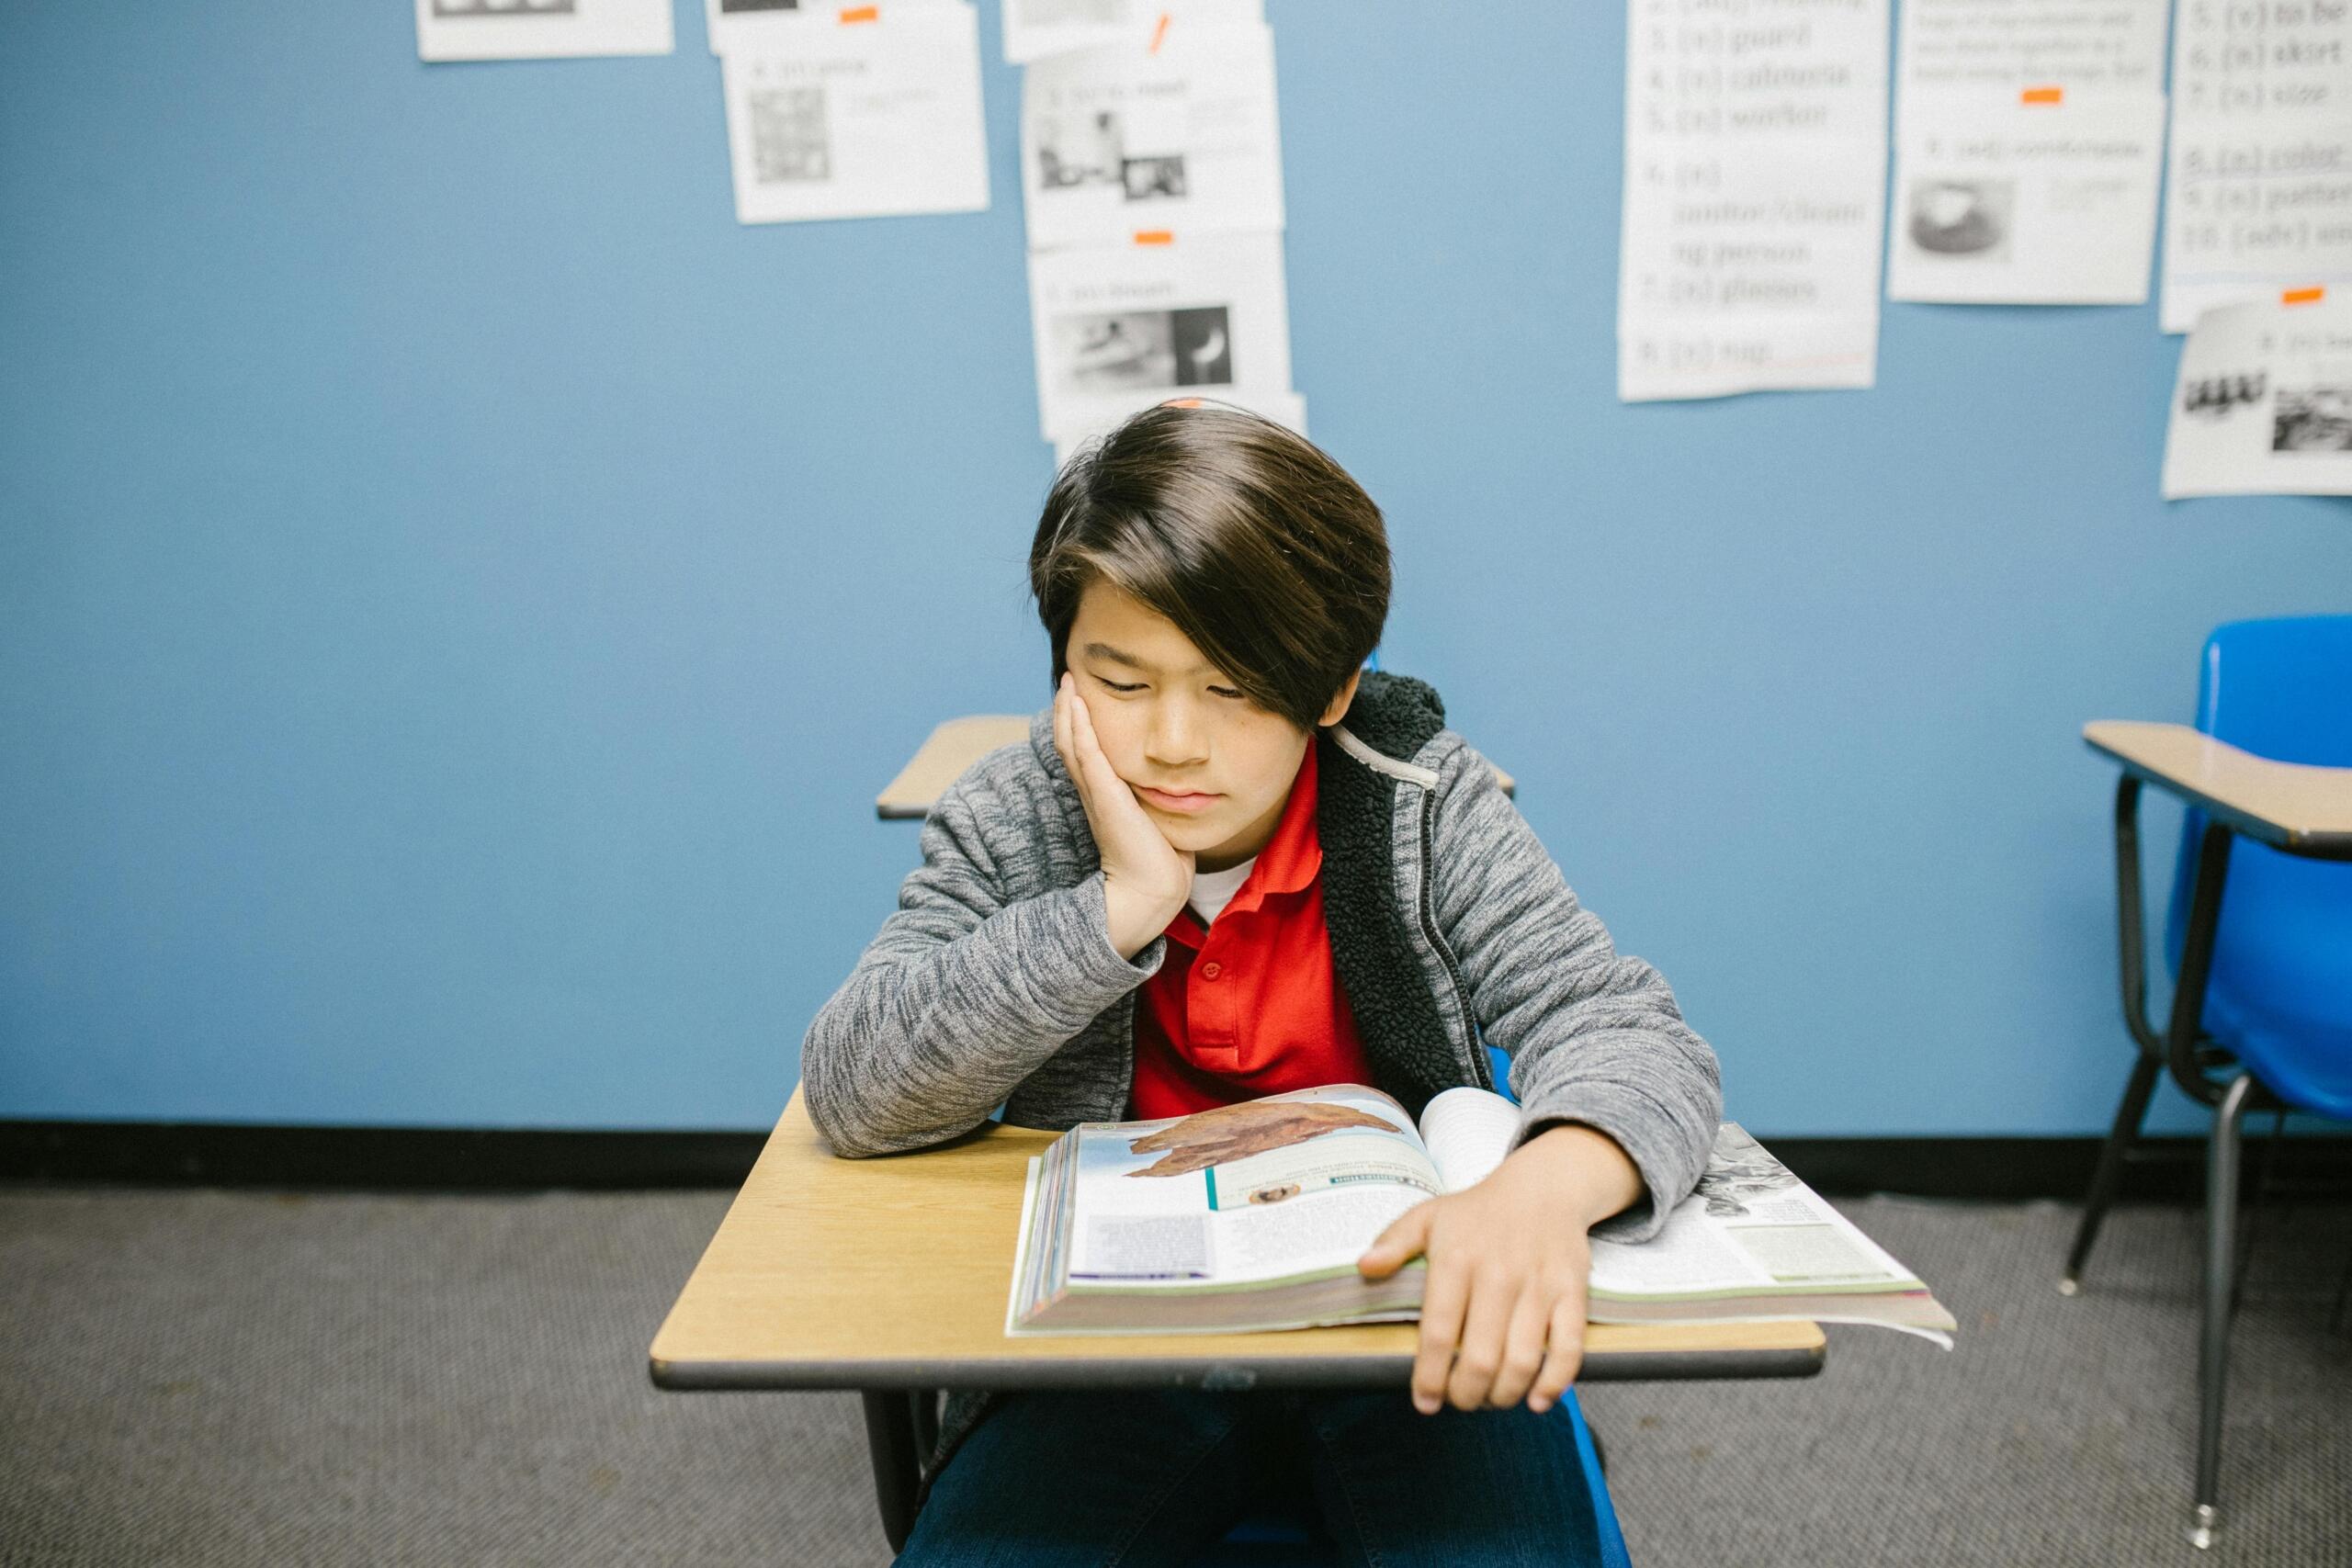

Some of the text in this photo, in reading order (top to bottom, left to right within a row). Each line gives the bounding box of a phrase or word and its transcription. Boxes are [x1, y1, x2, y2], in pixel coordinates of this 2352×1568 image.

[1730, 22, 1813, 55] guard
[2274, 37, 2343, 64] skirt
[1730, 62, 1851, 89] cafeteria
[1731, 101, 1828, 129] worker
